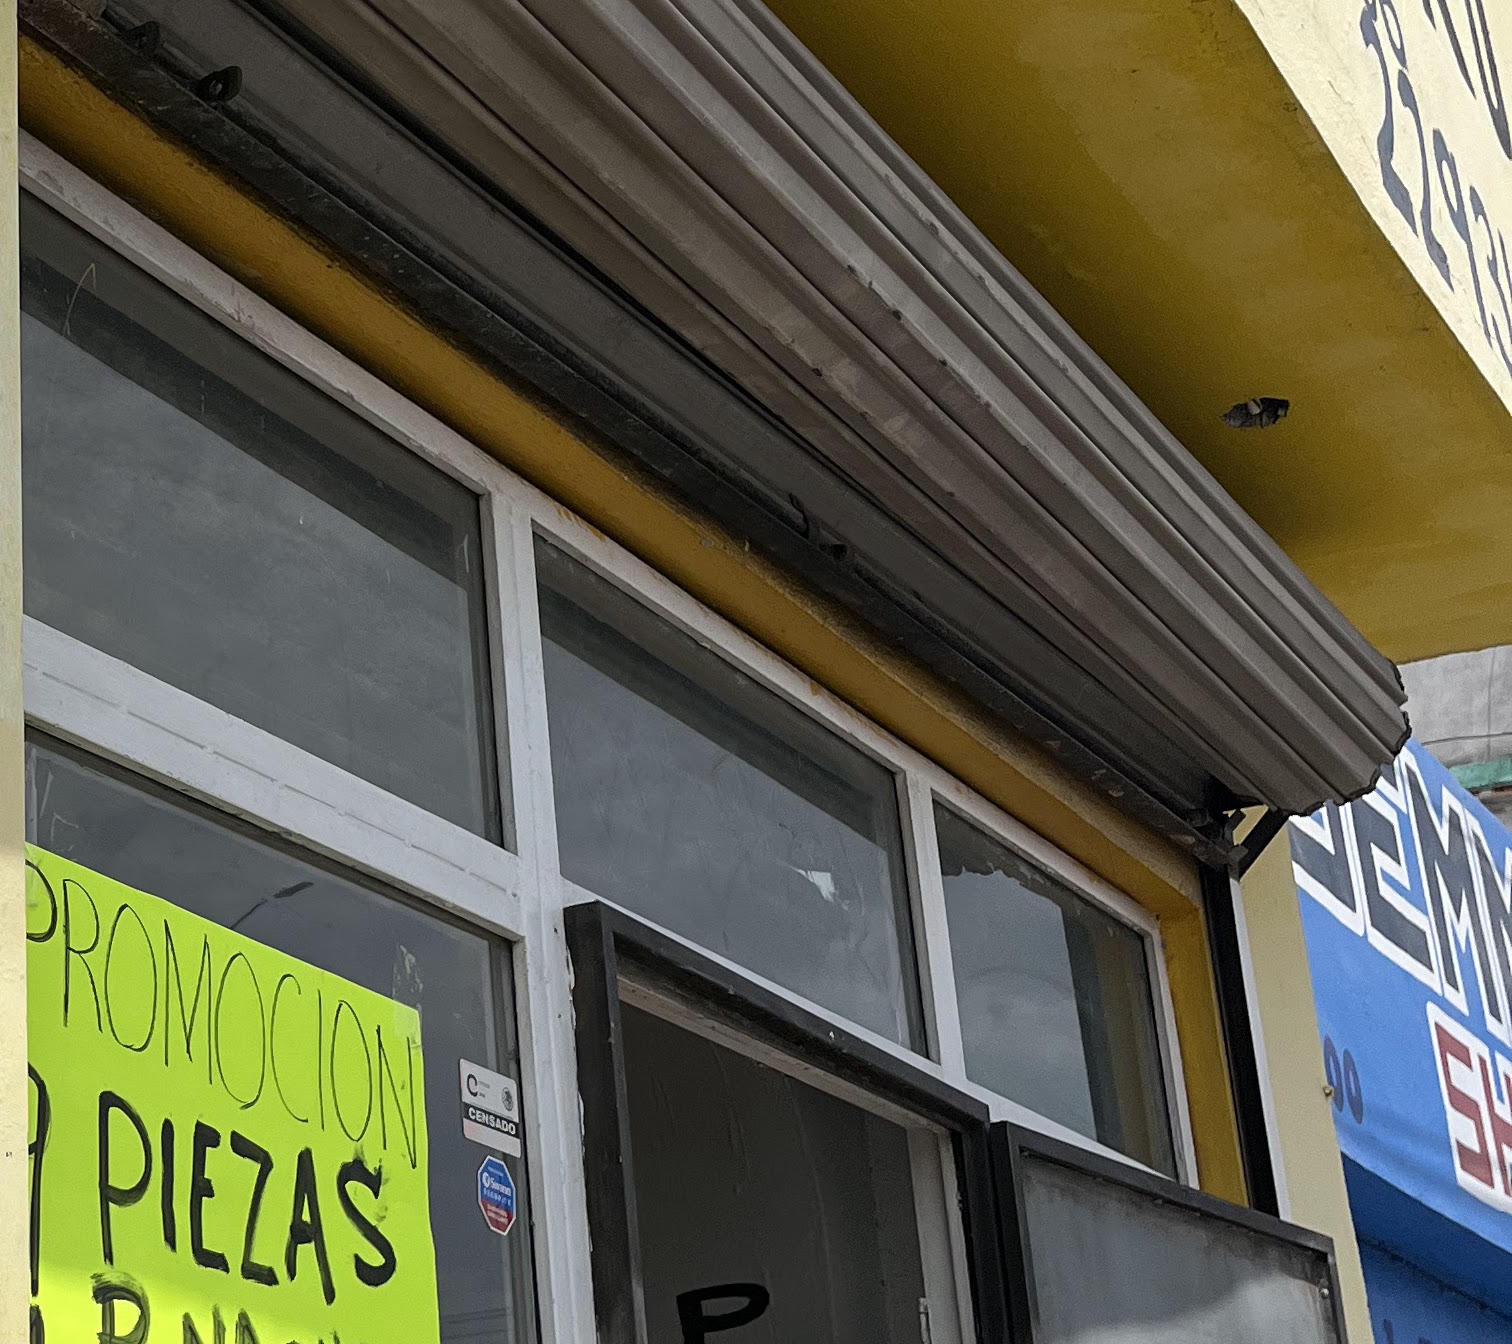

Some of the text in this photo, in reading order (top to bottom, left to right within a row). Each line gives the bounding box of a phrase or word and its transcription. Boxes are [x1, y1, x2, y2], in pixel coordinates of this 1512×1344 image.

[1359, 7, 1512, 378] 2293
[25, 859, 417, 1170] PROMOCION
[468, 1106, 517, 1135] CENSADO
[98, 1089, 400, 1307] PIEZAS
